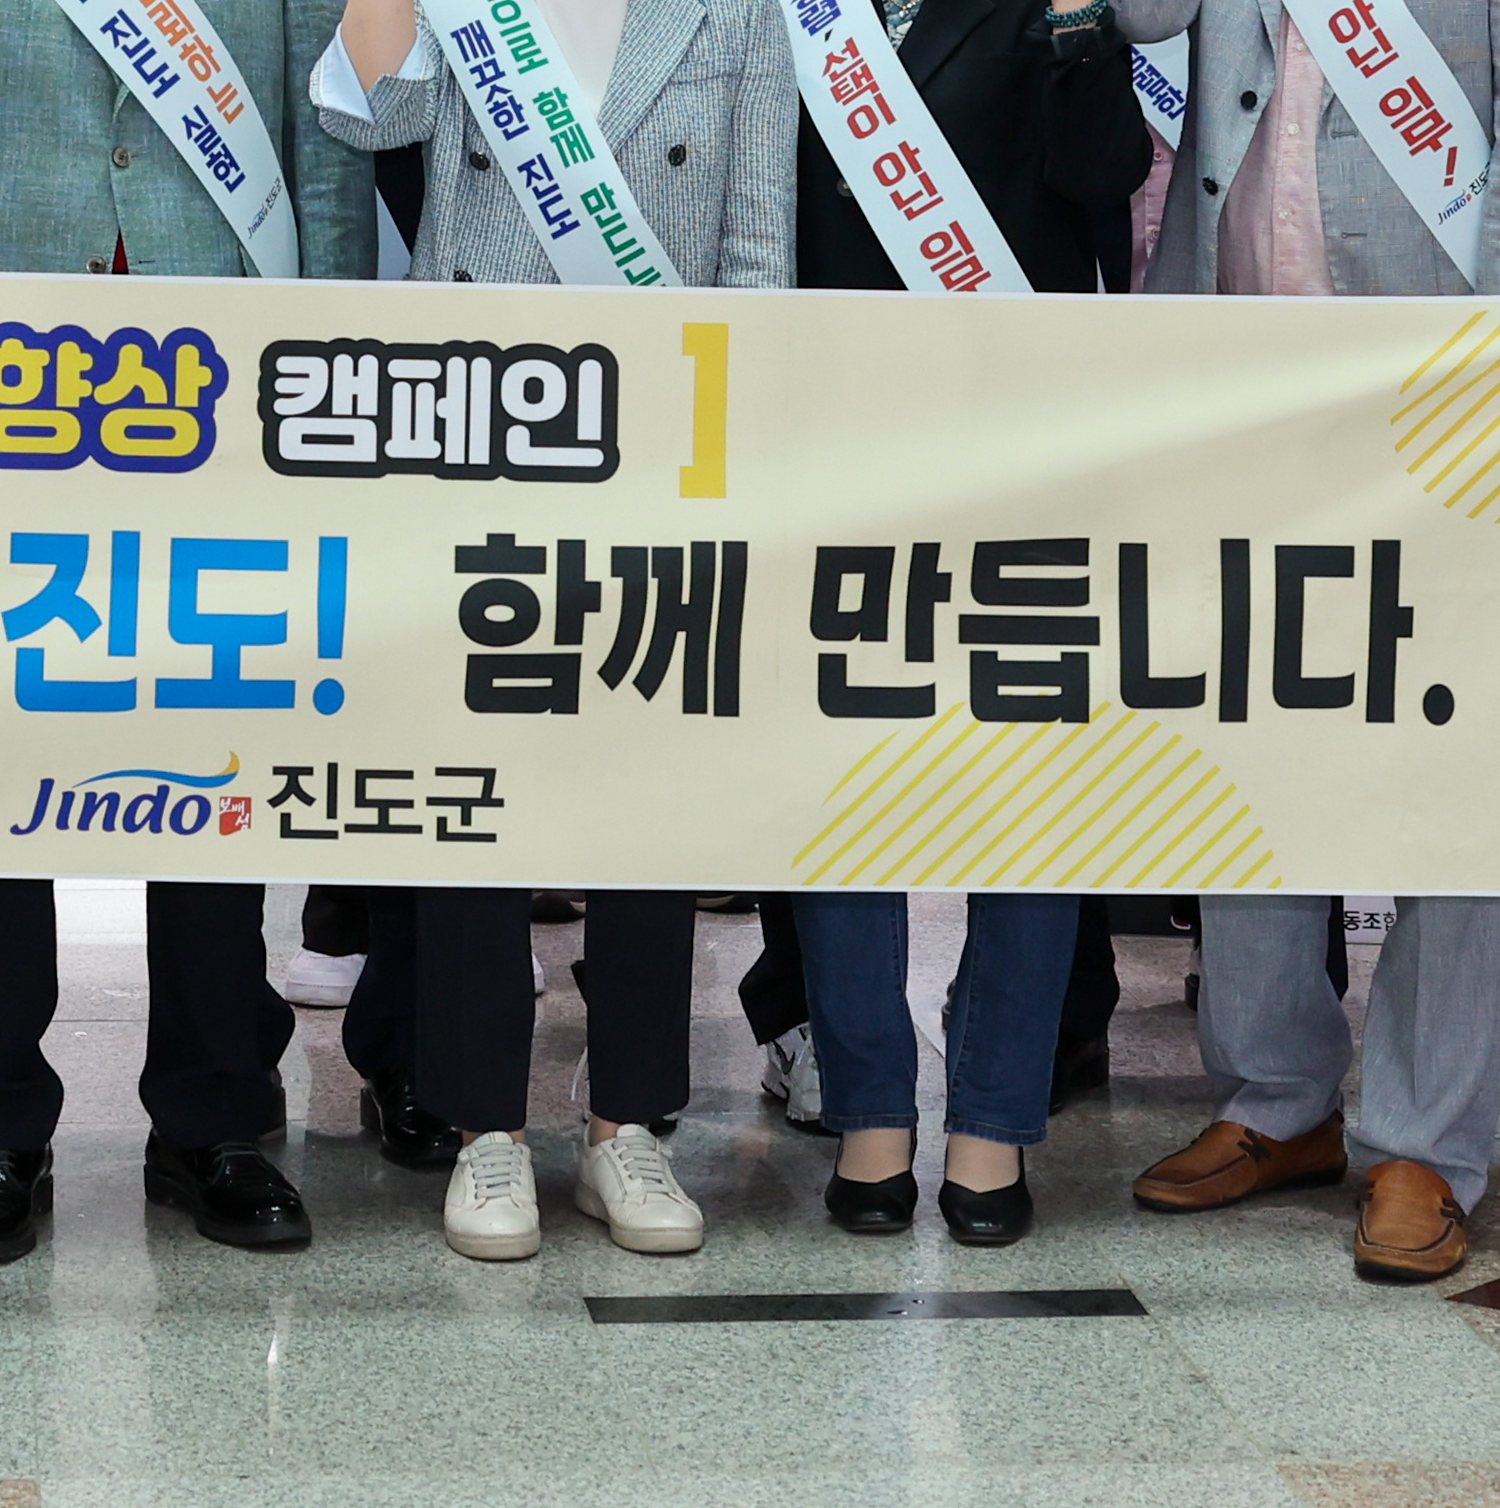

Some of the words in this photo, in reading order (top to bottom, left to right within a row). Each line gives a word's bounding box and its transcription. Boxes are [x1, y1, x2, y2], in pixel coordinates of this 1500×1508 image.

[100, 8, 181, 99] 진도
[531, 85, 595, 168] 함께
[516, 153, 582, 241] 진도
[263, 340, 618, 480] 캠페인
[1, 529, 347, 718] 진도!
[453, 533, 749, 719] 함께
[809, 536, 1456, 726] 만듭니다.
[10, 767, 213, 838] Jindo
[266, 759, 506, 844] 진도군
